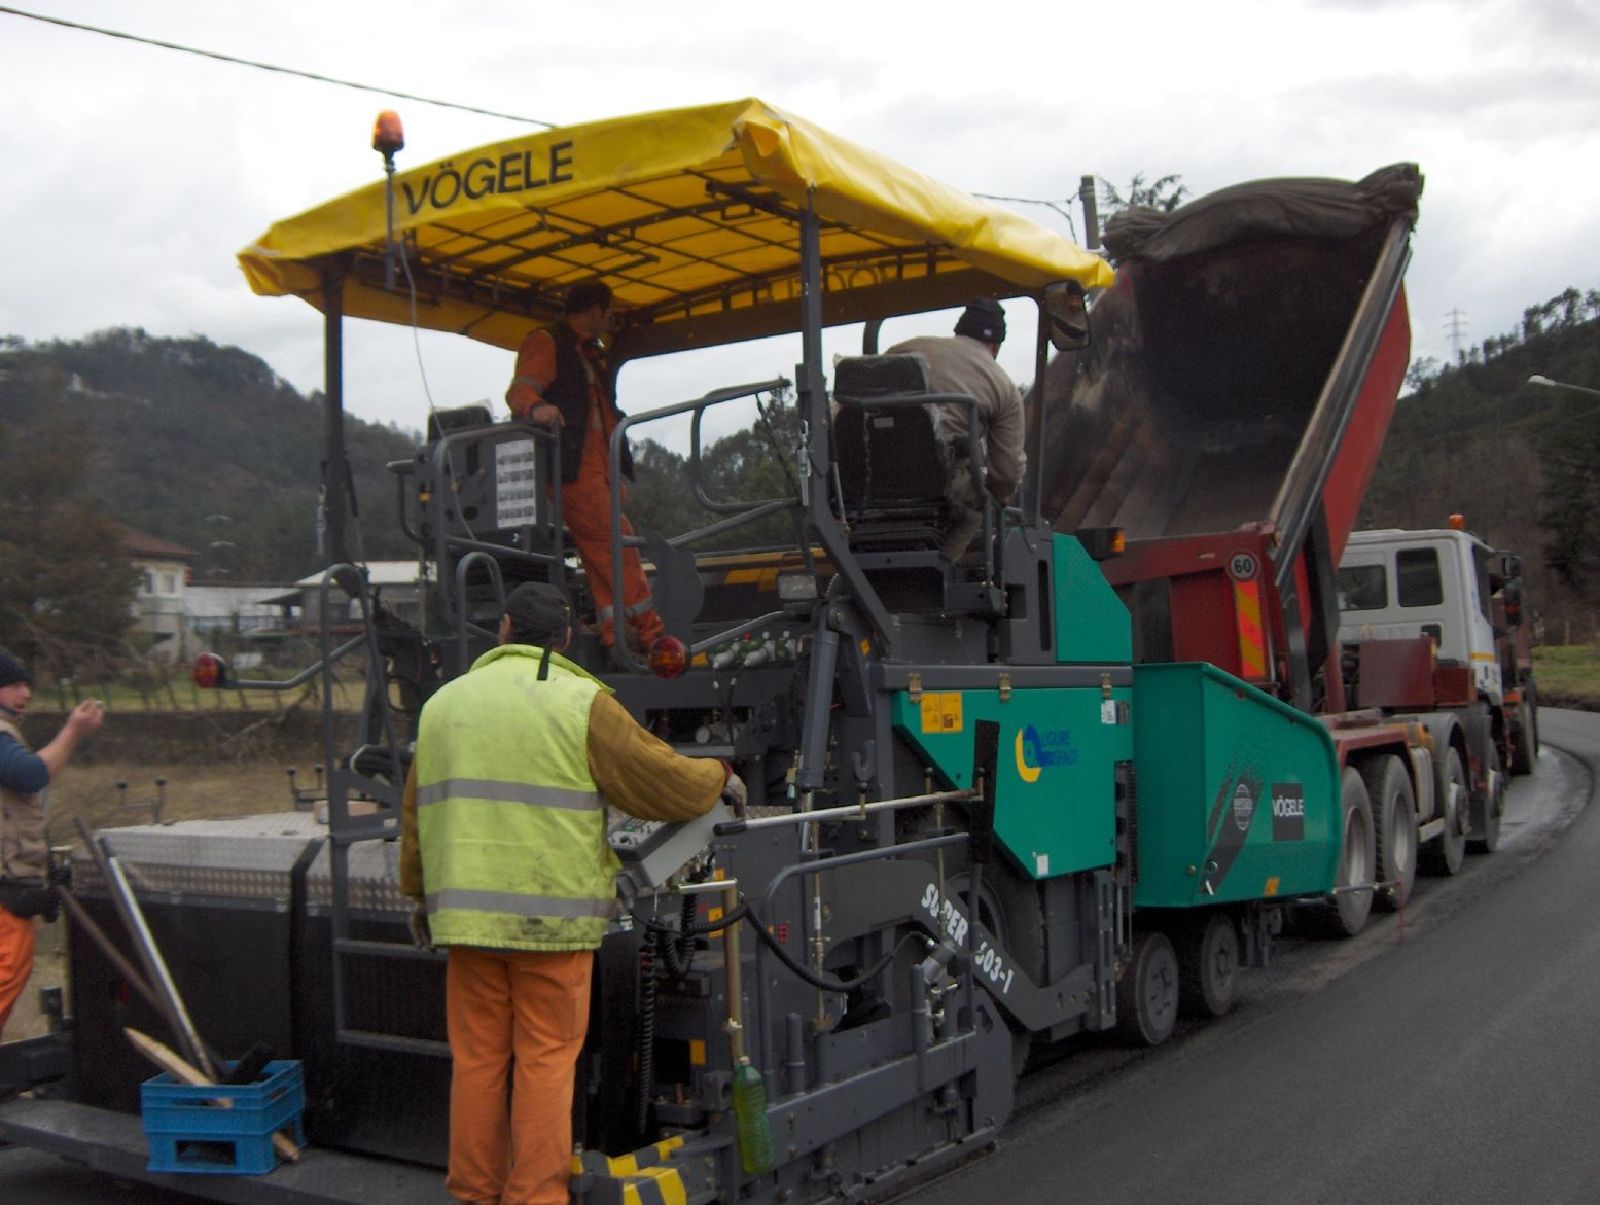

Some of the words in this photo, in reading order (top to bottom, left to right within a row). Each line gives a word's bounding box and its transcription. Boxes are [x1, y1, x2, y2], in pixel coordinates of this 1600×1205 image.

[402, 140, 573, 215] VÖGELE
[1234, 558, 1252, 574] 60
[1271, 794, 1305, 817] VÖGELE
